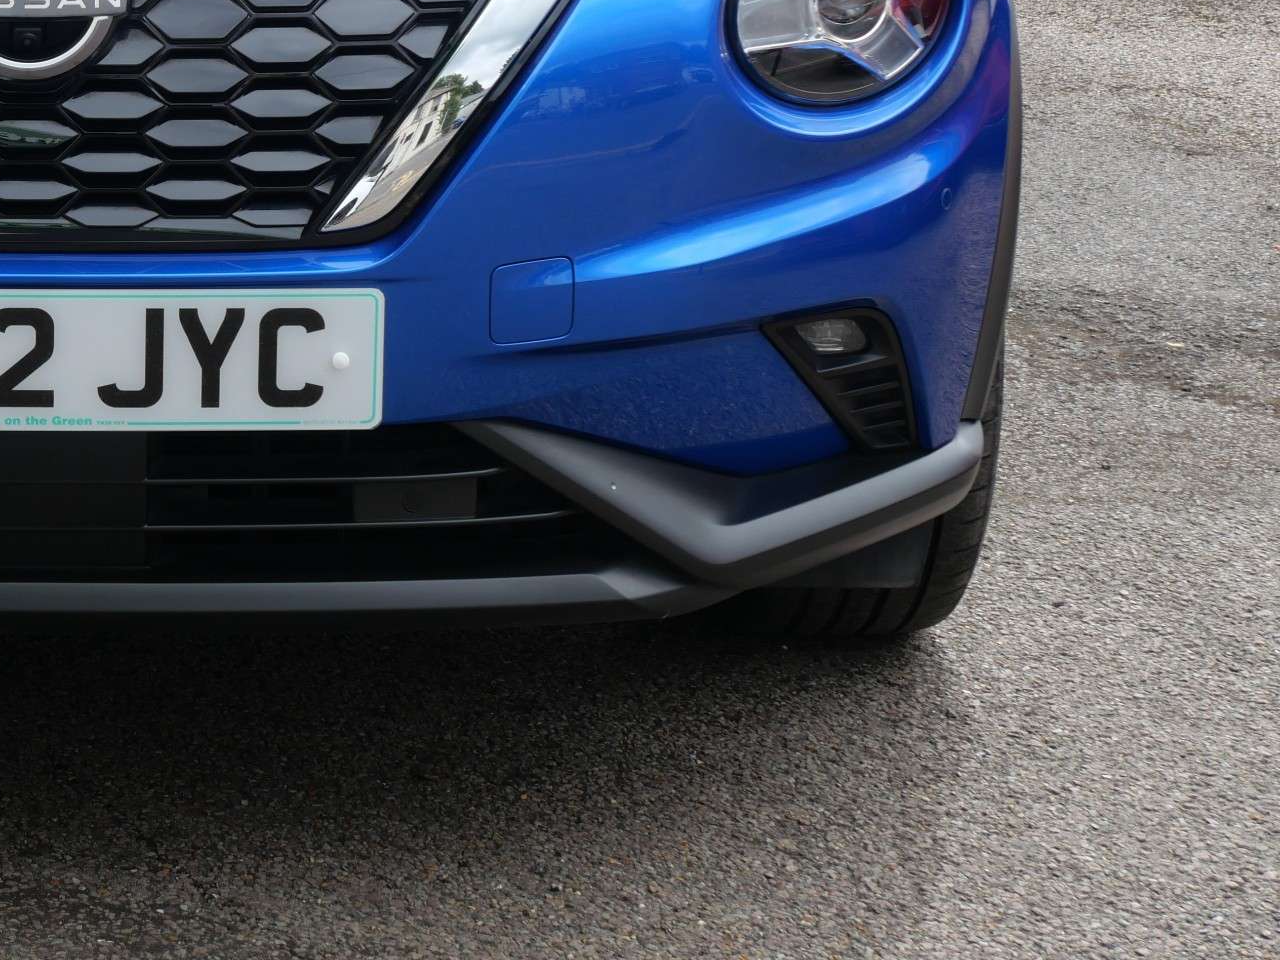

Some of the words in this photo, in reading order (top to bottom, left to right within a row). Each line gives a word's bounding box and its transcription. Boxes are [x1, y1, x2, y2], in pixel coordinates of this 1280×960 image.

[97, 307, 326, 408] JYC
[4, 416, 21, 426] on
[25, 415, 48, 426] the
[51, 416, 93, 426] Green
